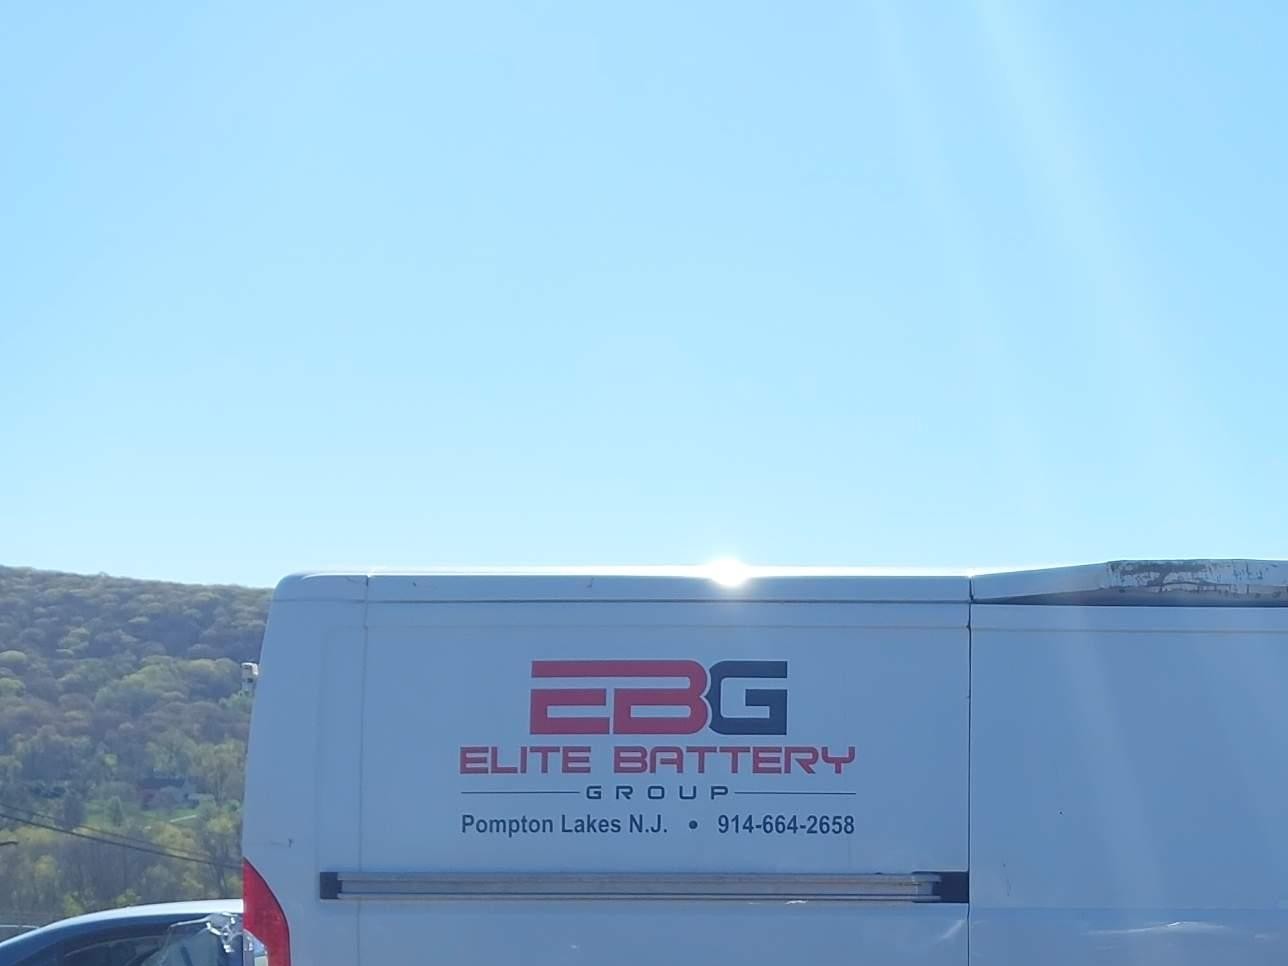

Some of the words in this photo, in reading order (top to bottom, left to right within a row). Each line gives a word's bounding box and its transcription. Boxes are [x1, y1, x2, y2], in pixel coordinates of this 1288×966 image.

[530, 659, 788, 736] EBG
[459, 745, 592, 775] ELITE
[613, 745, 856, 775] BATTERY
[585, 785, 729, 801] GROUP
[461, 814, 554, 838] Pompton
[561, 814, 622, 834] Lakes
[629, 815, 668, 834] N.J.
[717, 815, 856, 835] 914-664-2658
